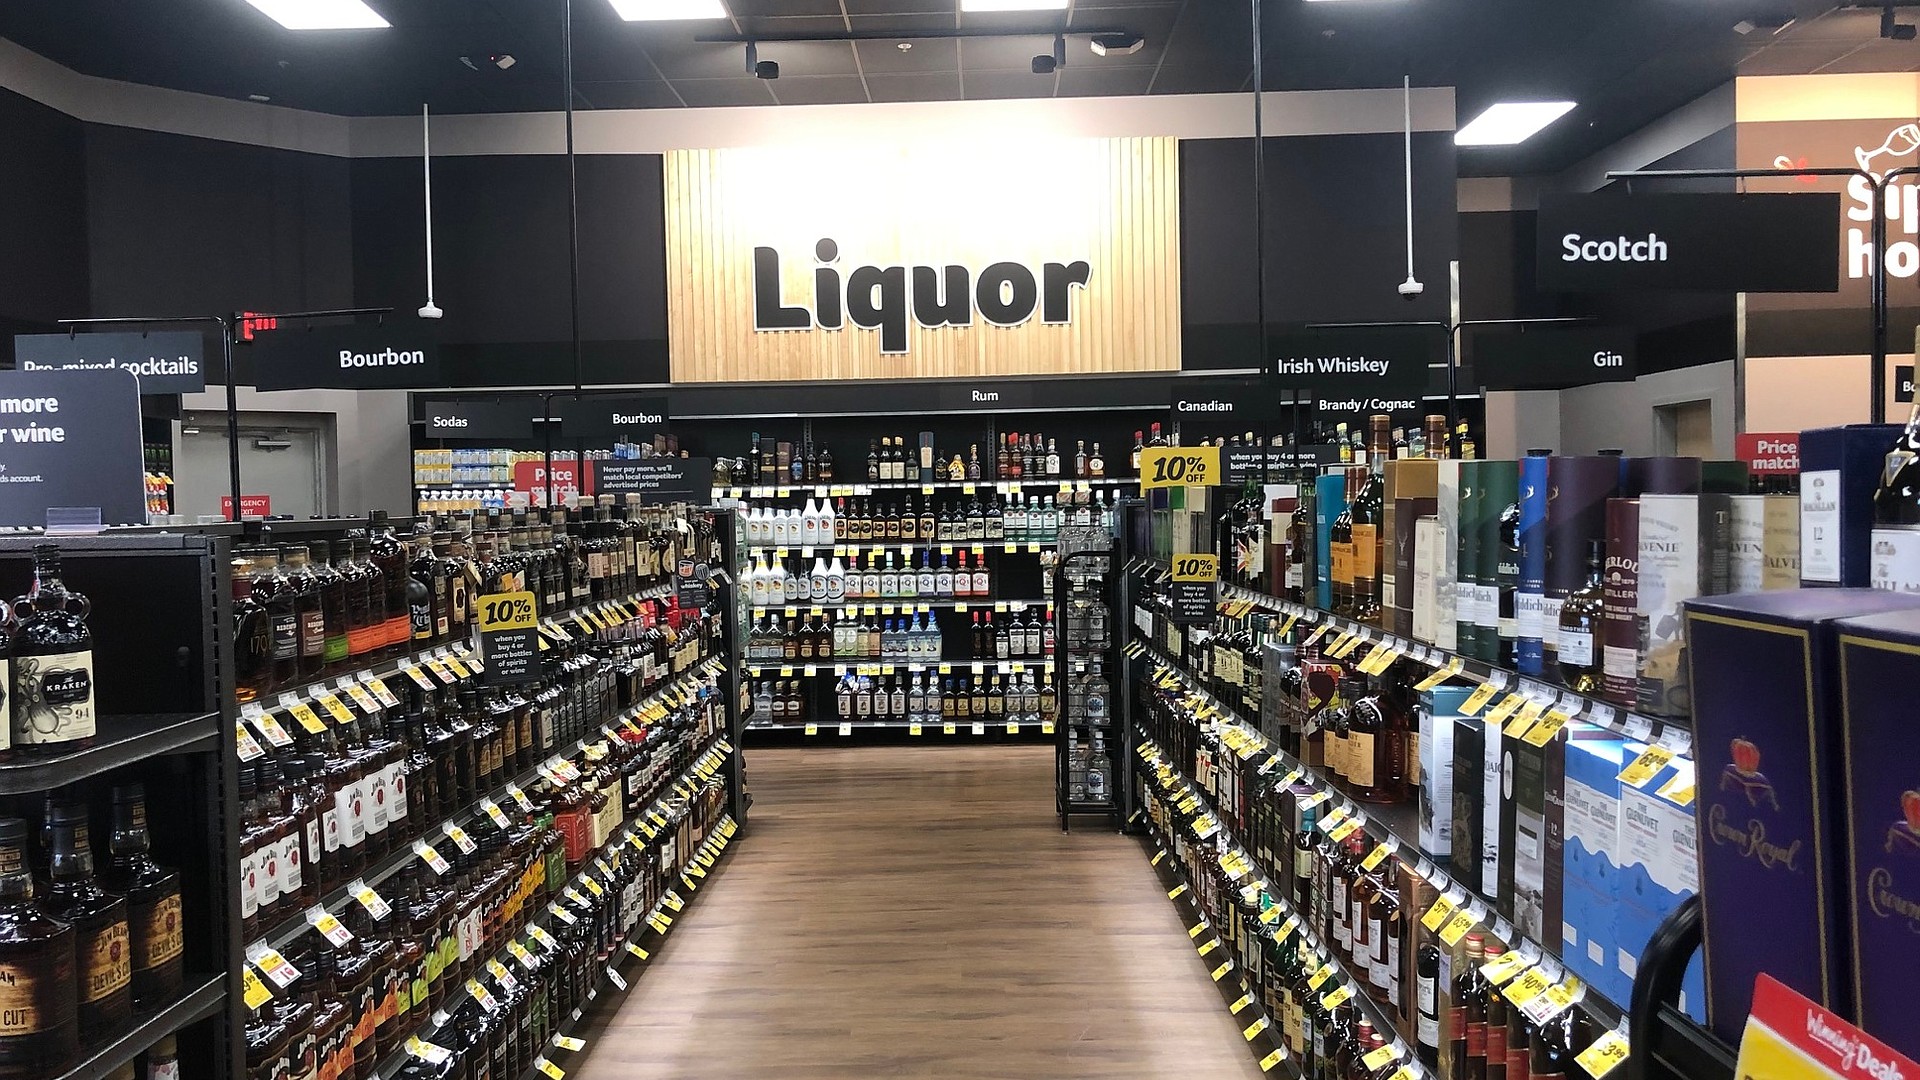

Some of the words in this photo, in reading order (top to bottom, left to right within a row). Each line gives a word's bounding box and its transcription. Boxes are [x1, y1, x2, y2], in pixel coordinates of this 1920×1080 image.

[1562, 233, 1667, 261] Scotch
[753, 238, 1092, 354] Liquor
[339, 347, 424, 368] Bourbon
[1593, 351, 1623, 367] Gin
[120, 356, 198, 376] cocktails
[1278, 358, 1314, 374] Irish
[1317, 357, 1390, 375] Whiskey
[972, 390, 998, 402] Rum
[0, 397, 59, 413] more
[1177, 400, 1233, 412] Canadian
[1319, 399, 1362, 413] Brandy
[1371, 398, 1416, 411] Cognac
[433, 416, 468, 428] Sodas
[612, 412, 662, 425] Bourbon
[11, 422, 65, 443] wine
[1757, 441, 1797, 454] Price
[603, 465, 622, 473] Never
[1152, 456, 1206, 483] 10%
[1753, 455, 1799, 470] match
[535, 468, 572, 481] Pice
[603, 473, 623, 481] match
[1186, 474, 1206, 483] OFF
[603, 480, 637, 488] advertised
[638, 480, 660, 489] prices
[1176, 559, 1213, 576] 10%
[485, 599, 531, 625] 10%
[515, 614, 531, 623] OFF
[513, 634, 526, 642] you
[509, 650, 533, 658] bottles
[506, 659, 528, 667] spirits
[46, 680, 87, 691] KRAKEN
[1626, 807, 1659, 832] GLENLIVET
[0, 971, 15, 986] AM
[4, 1009, 26, 1025] CUT
[1807, 1008, 1859, 1070] Winning
